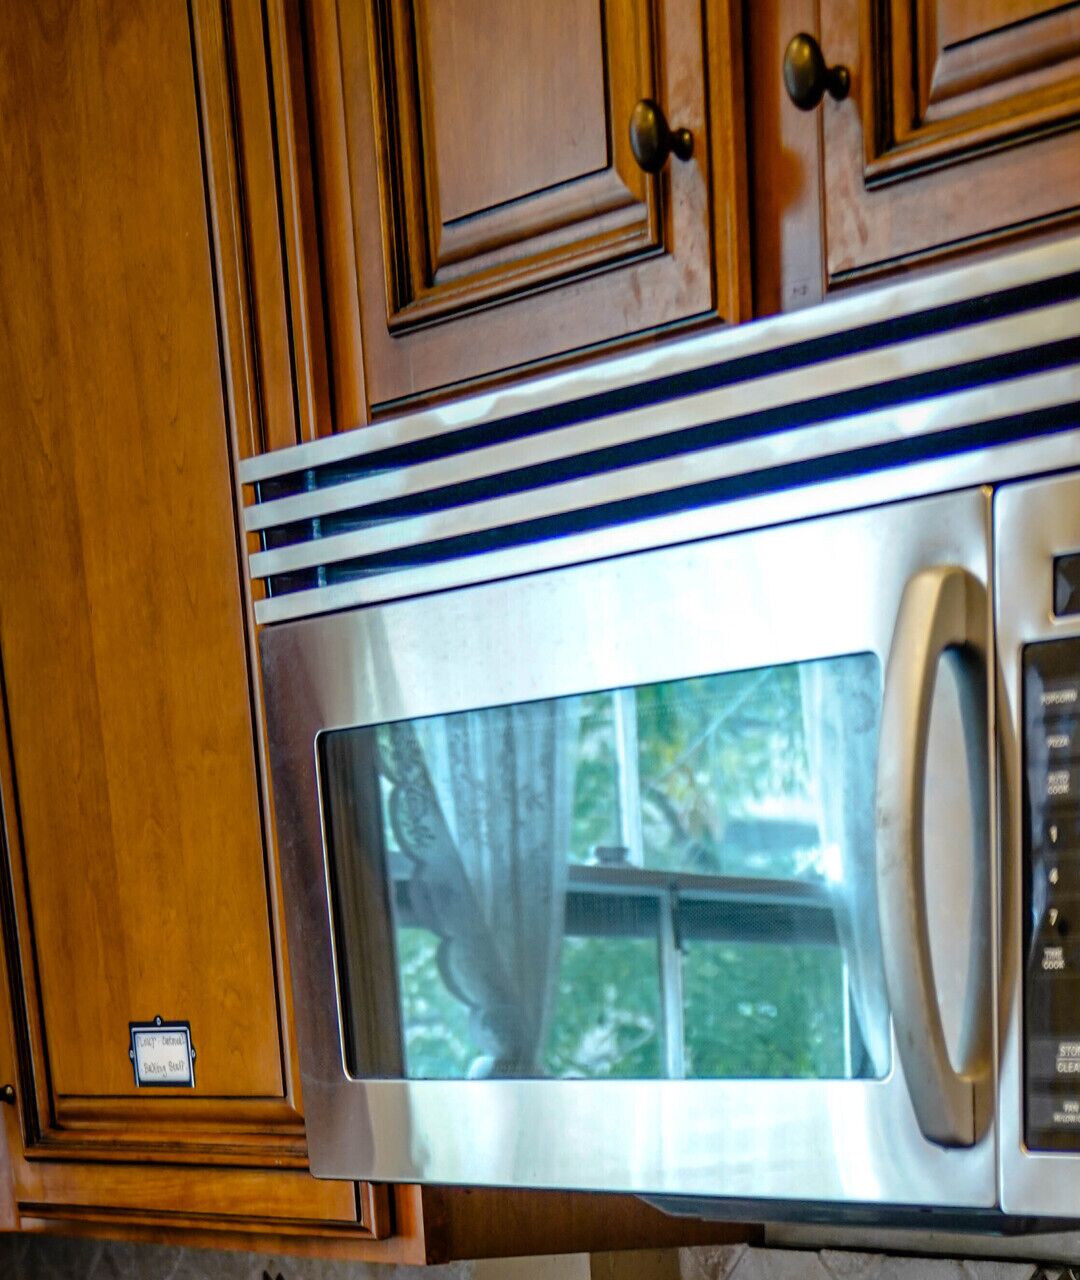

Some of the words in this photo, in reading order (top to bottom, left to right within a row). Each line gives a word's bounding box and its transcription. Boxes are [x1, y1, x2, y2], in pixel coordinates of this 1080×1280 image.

[1047, 735, 1070, 748] PIZZA
[1049, 826, 1058, 843] 1
[1049, 868, 1058, 885] 4
[1049, 908, 1058, 926] 7
[1042, 959, 1065, 970] COOK
